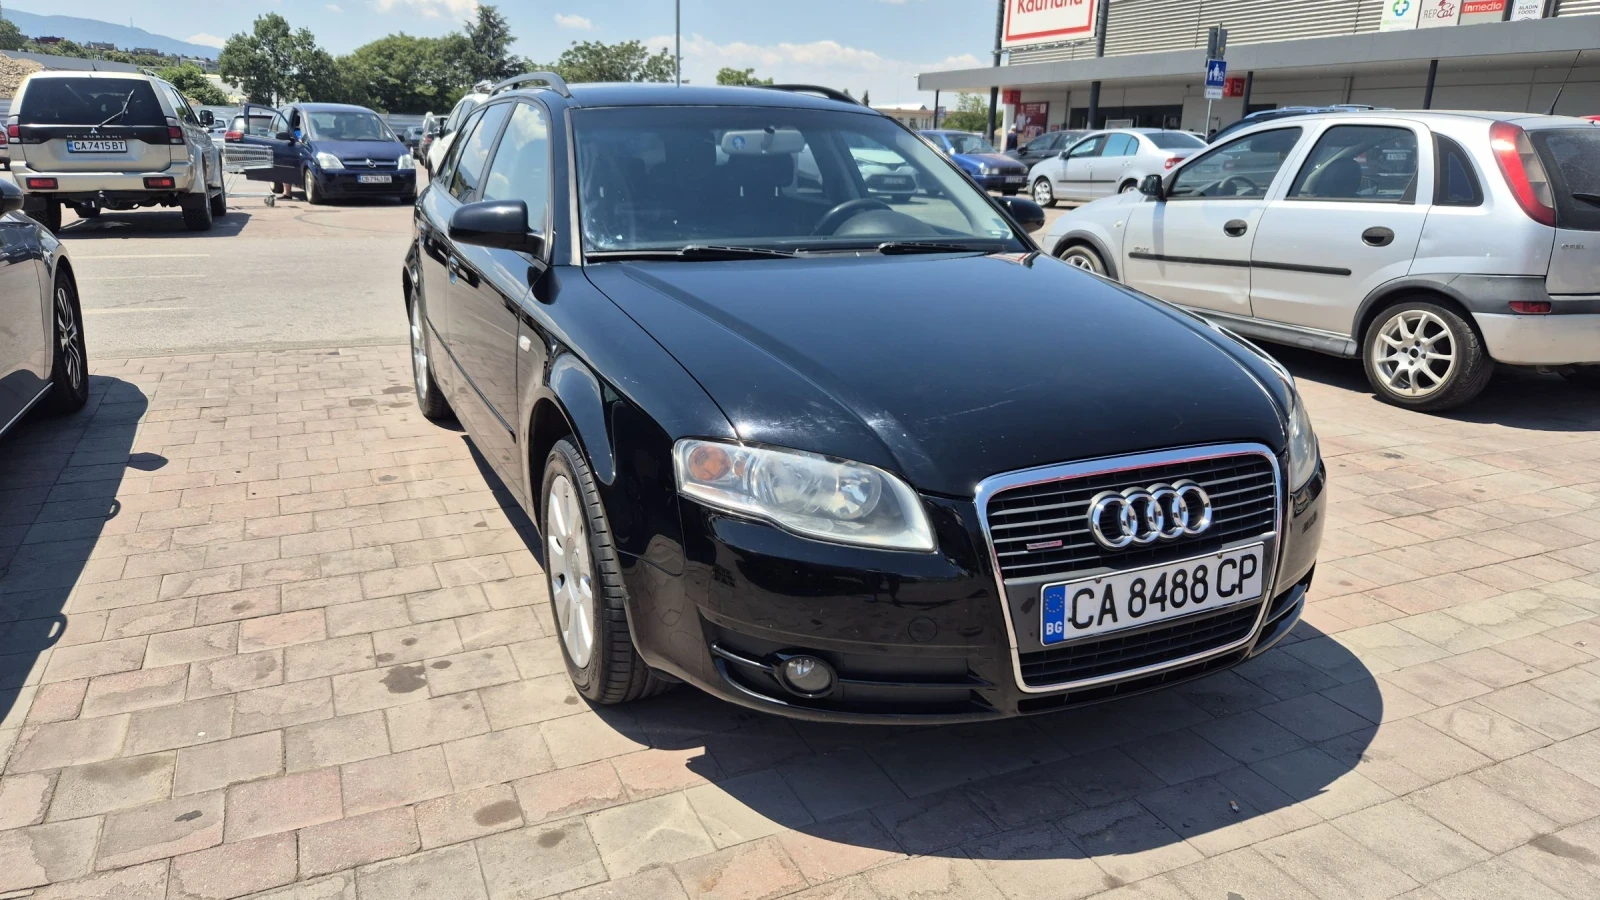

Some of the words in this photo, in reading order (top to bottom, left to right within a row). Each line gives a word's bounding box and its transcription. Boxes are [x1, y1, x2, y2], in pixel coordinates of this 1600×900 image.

[1017, 0, 1083, 14] Kaua
[1127, 564, 1209, 619] 8488
[1045, 620, 1063, 636] BG
